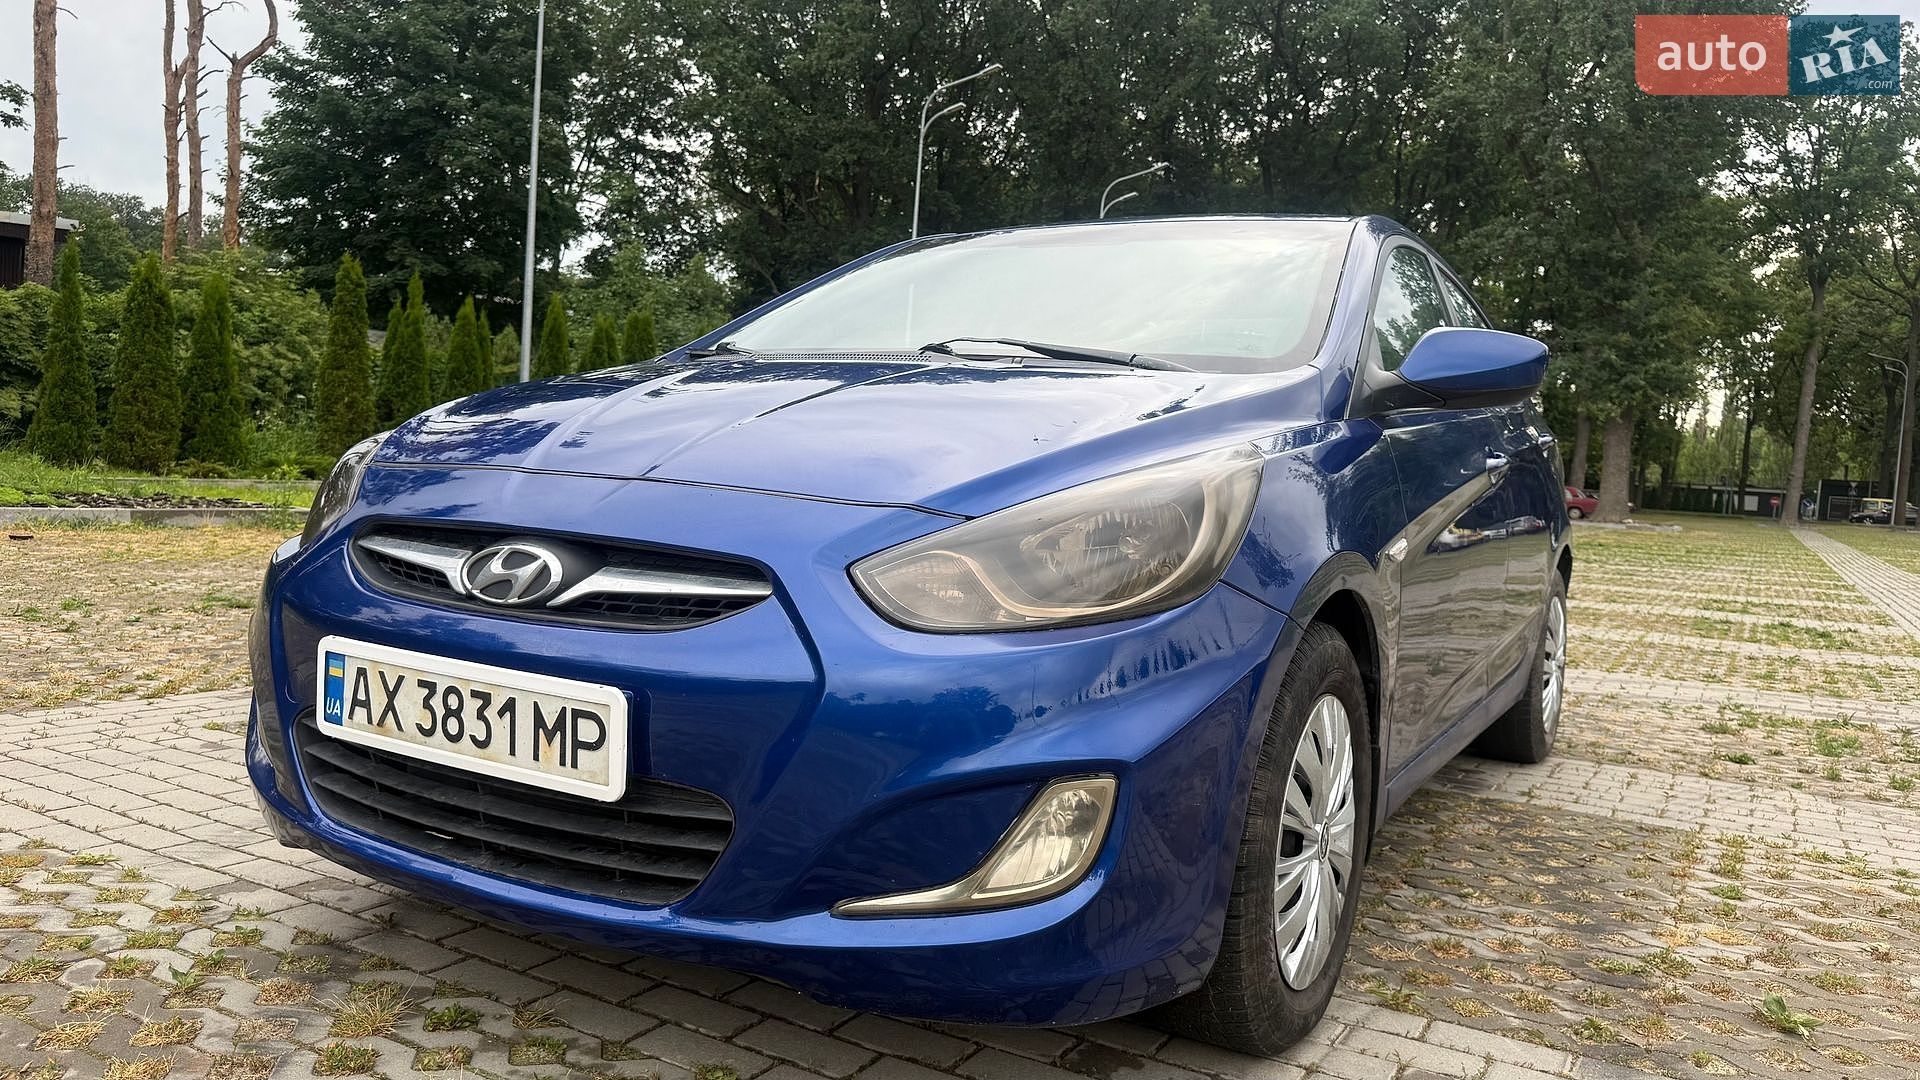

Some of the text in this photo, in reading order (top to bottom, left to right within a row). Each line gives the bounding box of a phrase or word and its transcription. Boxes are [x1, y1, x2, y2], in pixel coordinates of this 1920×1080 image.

[325, 696, 341, 717] UA
[348, 667, 607, 769] AX 3831 MP
